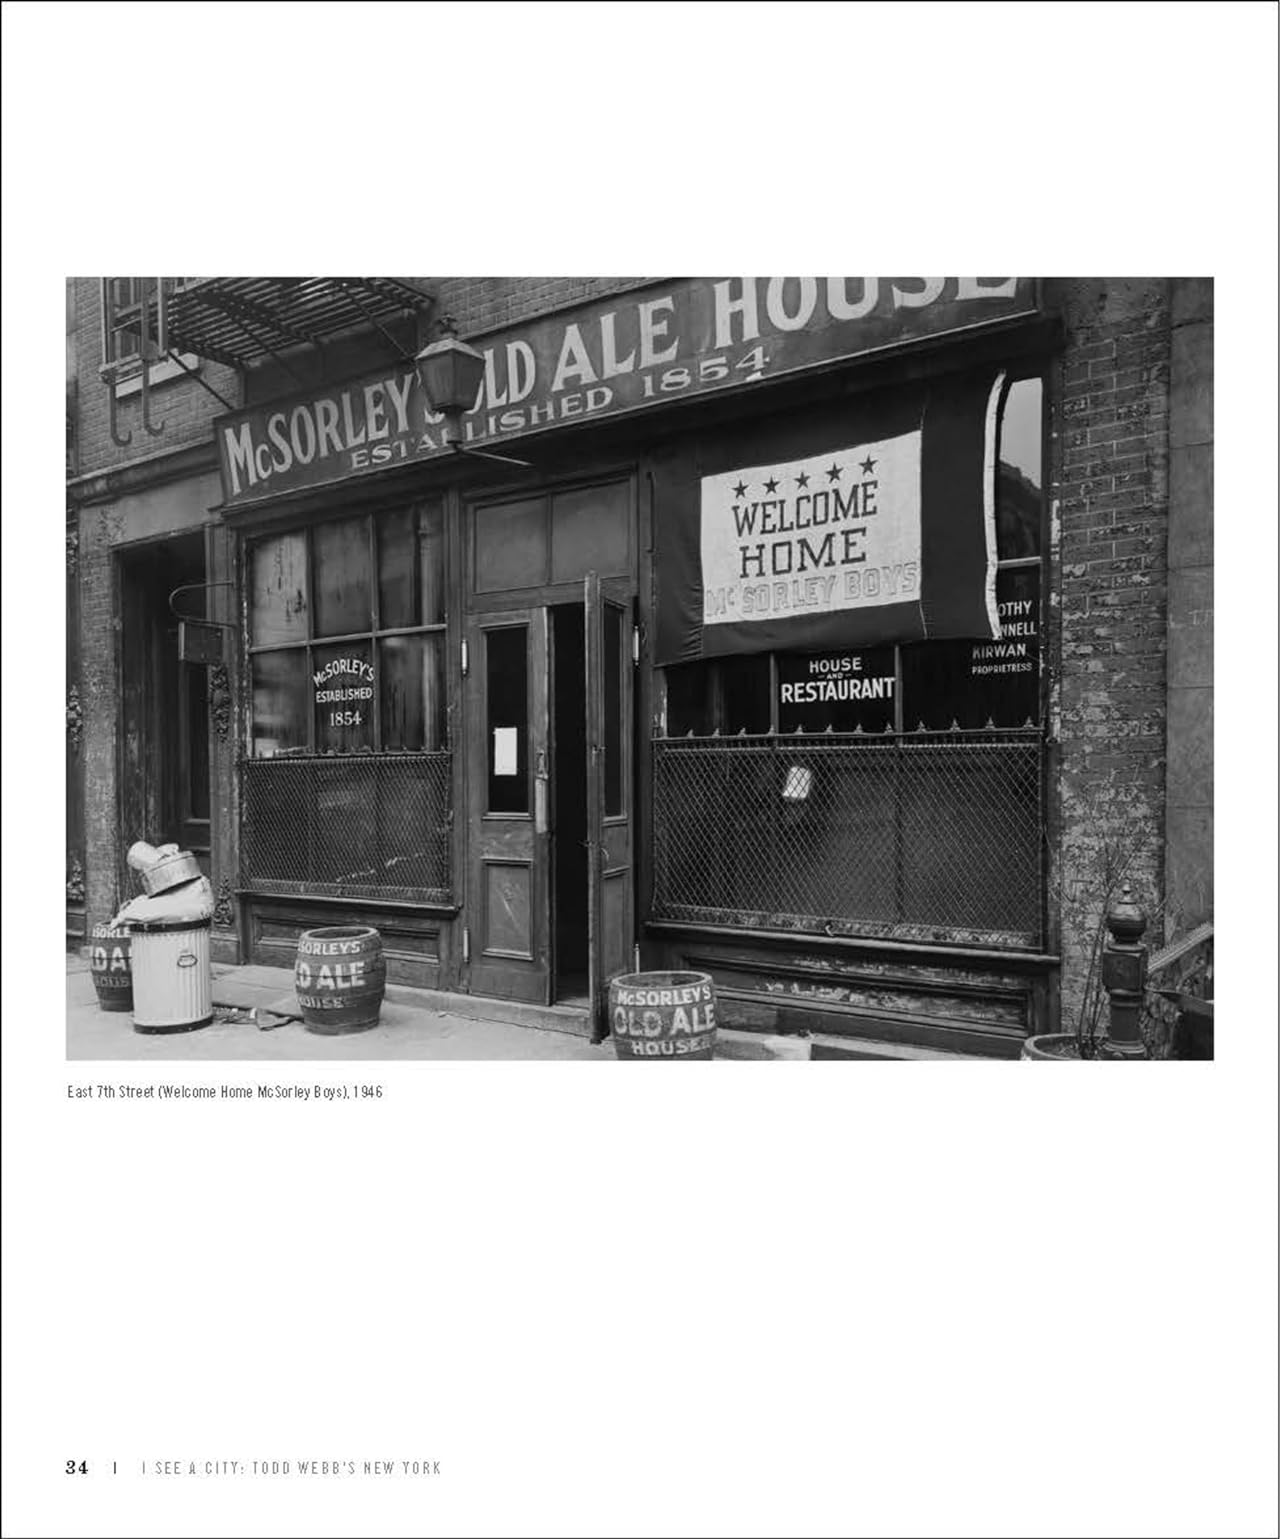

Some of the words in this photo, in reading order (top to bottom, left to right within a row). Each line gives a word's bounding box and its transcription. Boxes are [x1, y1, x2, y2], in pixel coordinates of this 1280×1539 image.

[644, 346, 770, 398] 1854
[224, 367, 446, 496] McSORLEY'
[462, 341, 536, 415] LD
[552, 296, 681, 393] ALE
[731, 480, 879, 538] WELCOME
[739, 526, 867, 579] HOME
[844, 562, 918, 601] BOYS
[997, 600, 1032, 617] OTHY
[1000, 621, 1037, 638] NNELL
[972, 643, 1026, 659] KIRWAN
[313, 658, 375, 688] McSORLEY'S
[809, 657, 862, 673] HOUSE
[826, 672, 844, 680] AND
[972, 662, 1033, 675] PROPRIETRESS
[316, 687, 373, 703] ESTABLISHED
[781, 677, 895, 703] RESTAURANT
[330, 710, 362, 727] 1854
[316, 962, 365, 990] ALE
[614, 1006, 662, 1038] OLD
[670, 1004, 716, 1035] ALE
